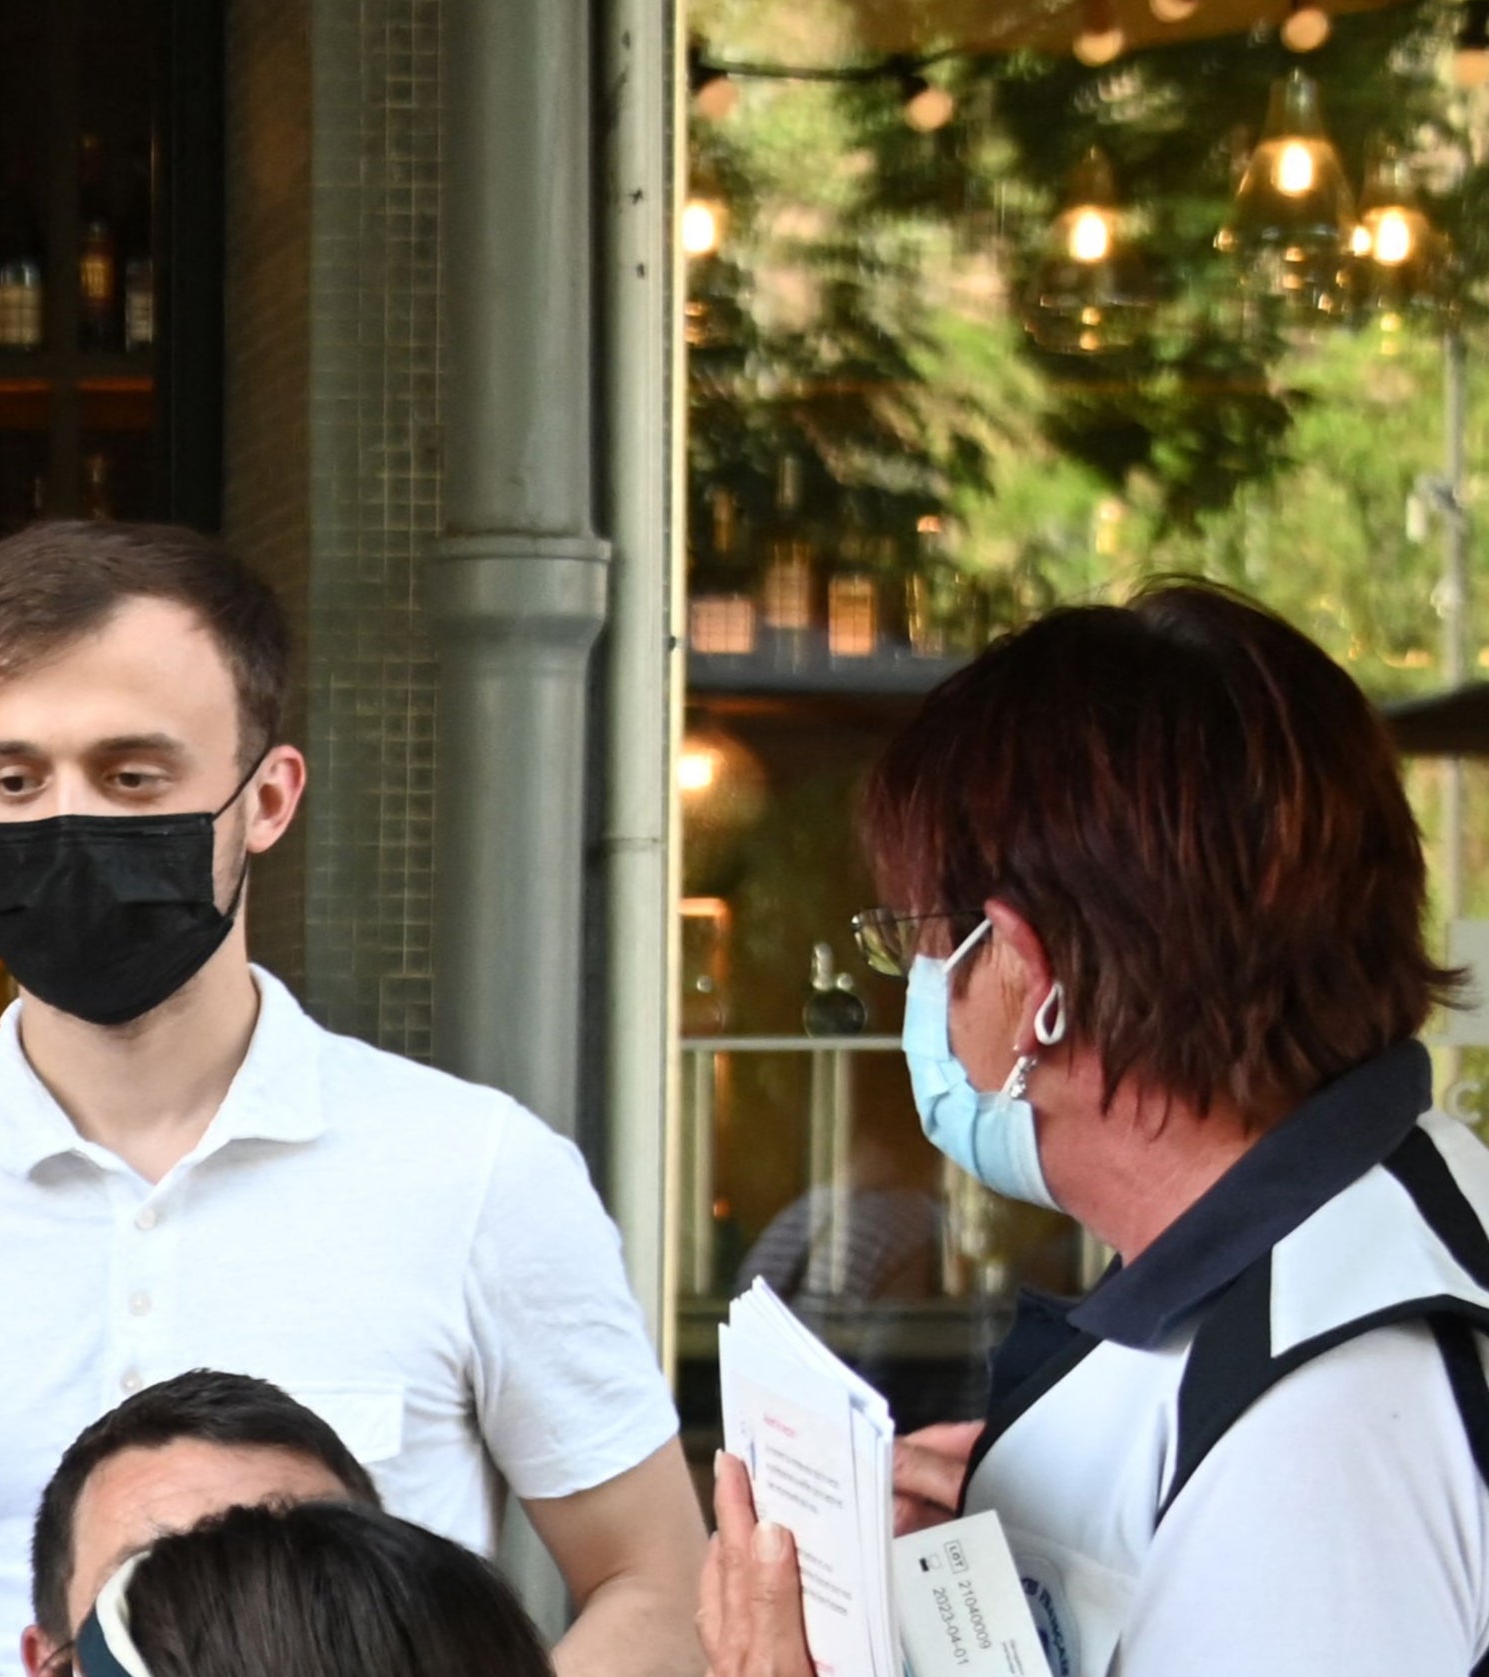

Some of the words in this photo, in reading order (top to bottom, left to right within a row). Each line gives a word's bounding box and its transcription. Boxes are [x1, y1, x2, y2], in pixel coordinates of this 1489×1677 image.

[932, 1586, 970, 1666] 2023-04-01
[948, 1545, 964, 1567] LOT
[958, 1579, 992, 1650] 21040009
